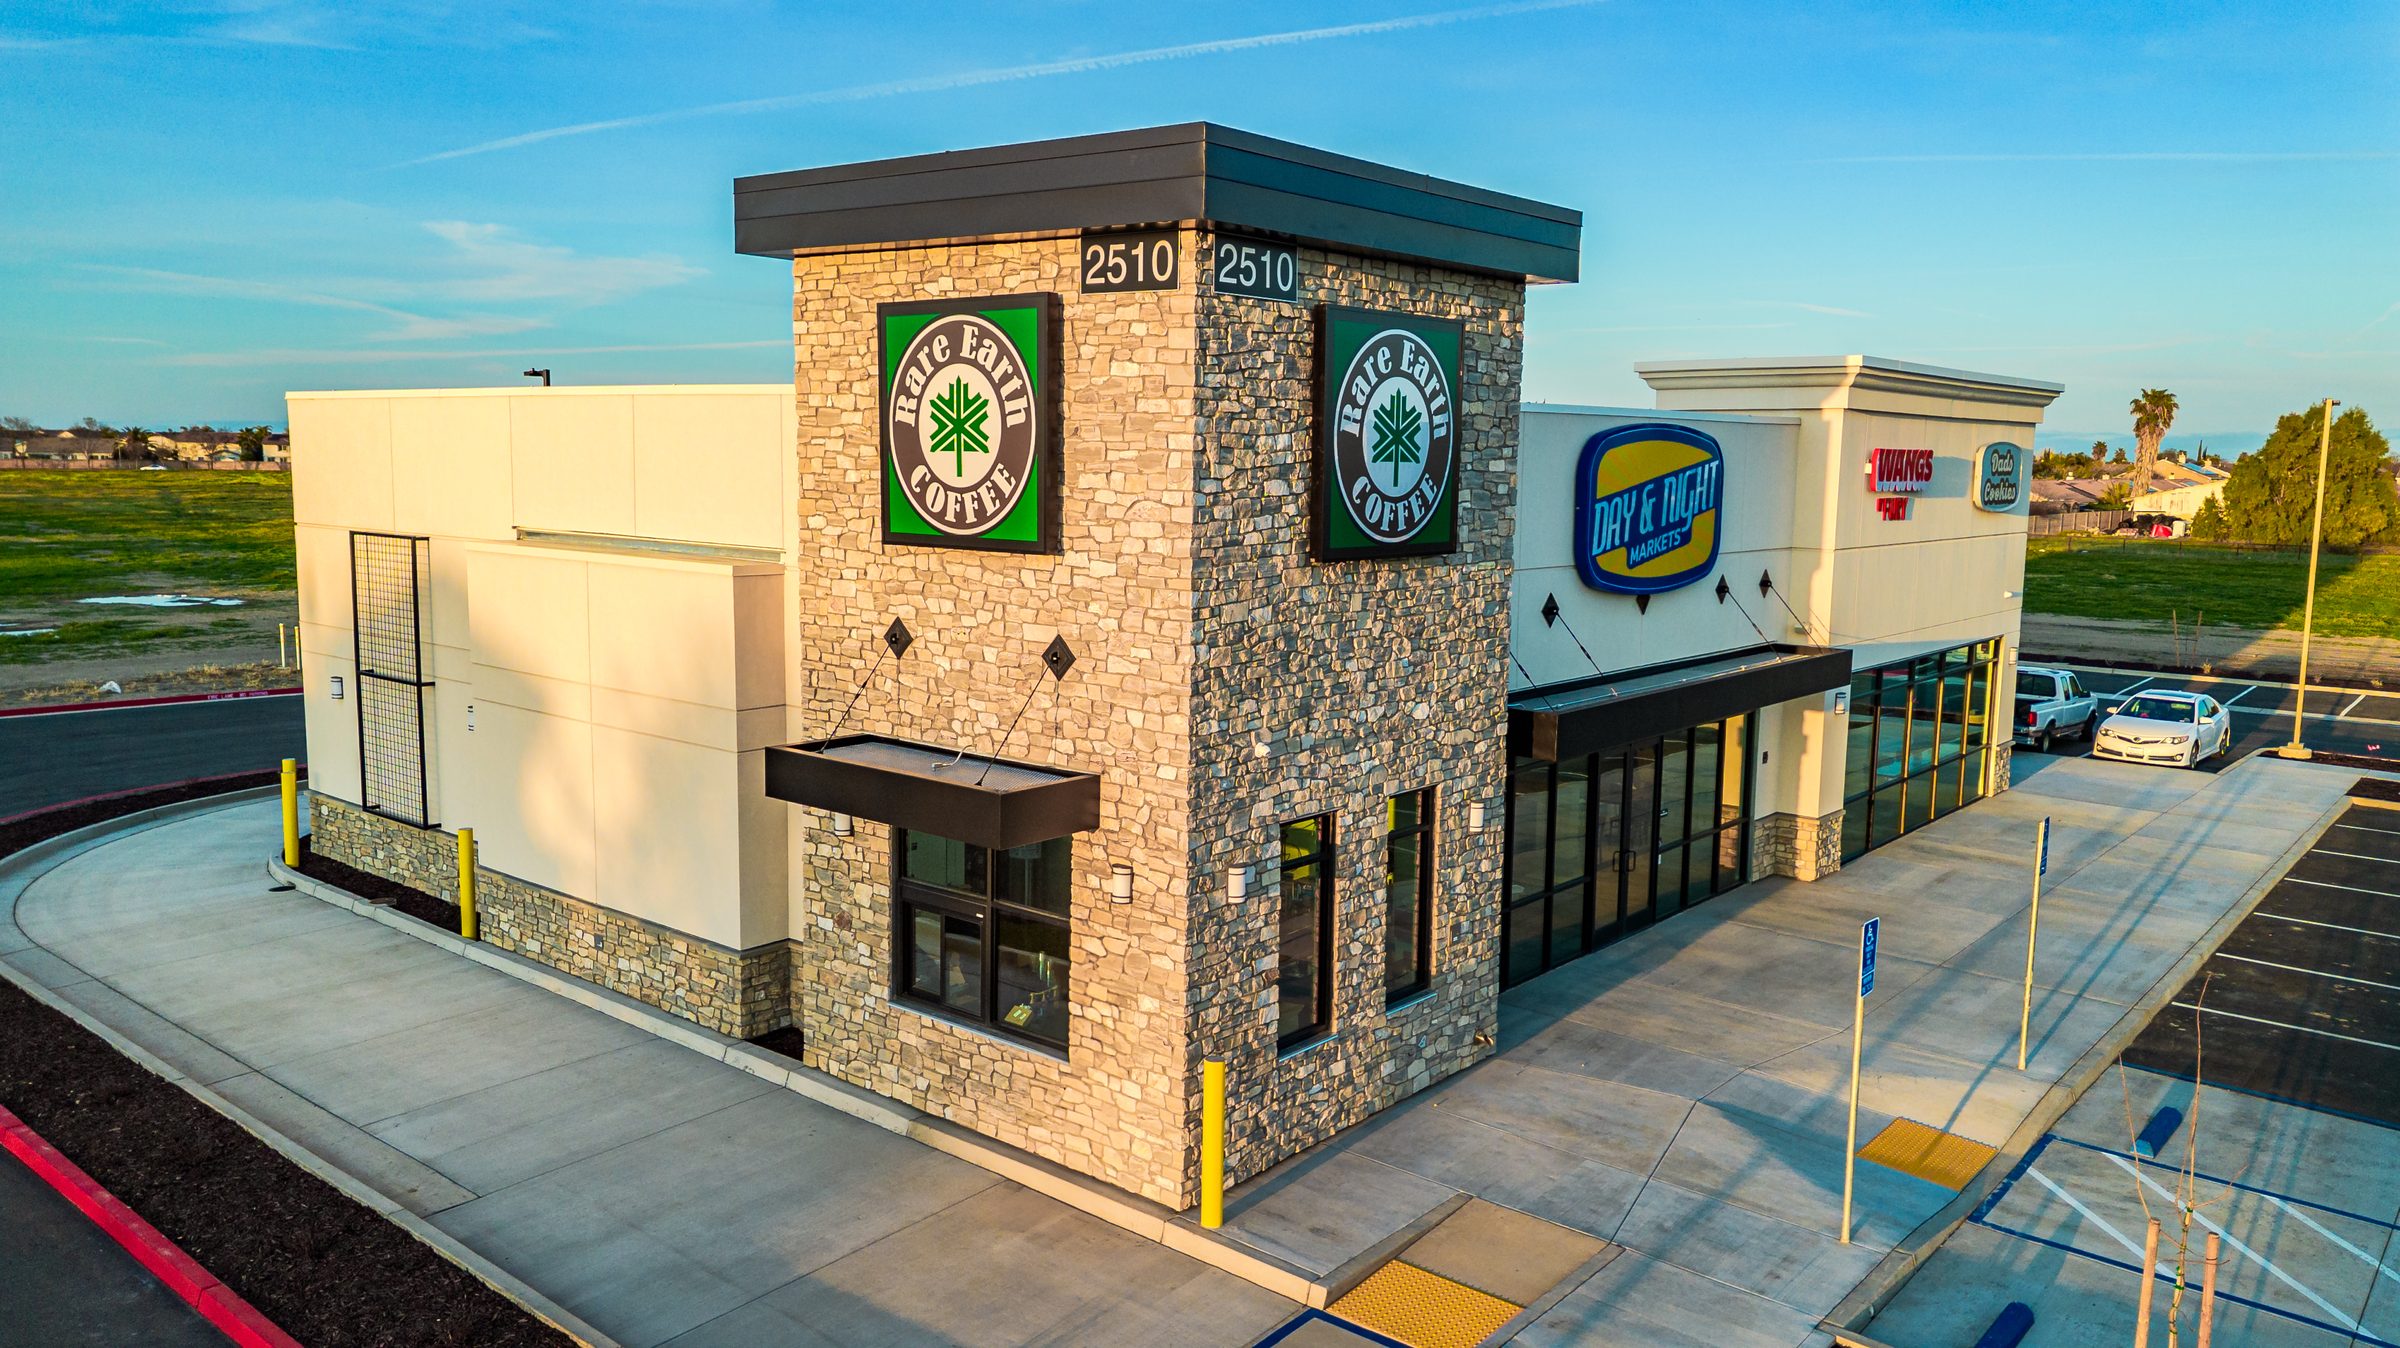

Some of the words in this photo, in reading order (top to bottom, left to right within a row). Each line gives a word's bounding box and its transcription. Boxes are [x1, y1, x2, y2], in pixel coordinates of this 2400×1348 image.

[1086, 240, 1173, 284] 2510
[1219, 243, 1293, 292] 2510
[895, 334, 950, 427] Rare
[959, 324, 1028, 428] Earth
[1340, 346, 1392, 438] Rare
[1400, 339, 1449, 440] Earth
[1876, 448, 1934, 483] WANGS
[1991, 452, 2014, 474] Dads
[910, 463, 1016, 524] COFFEE
[1352, 473, 1437, 531] COFFEE
[1592, 489, 1637, 556] DAY
[1639, 484, 1656, 534] &
[1661, 460, 1719, 532] NIGHT
[1984, 481, 2017, 503] Cookies
[1630, 528, 1681, 565] MARKETS
